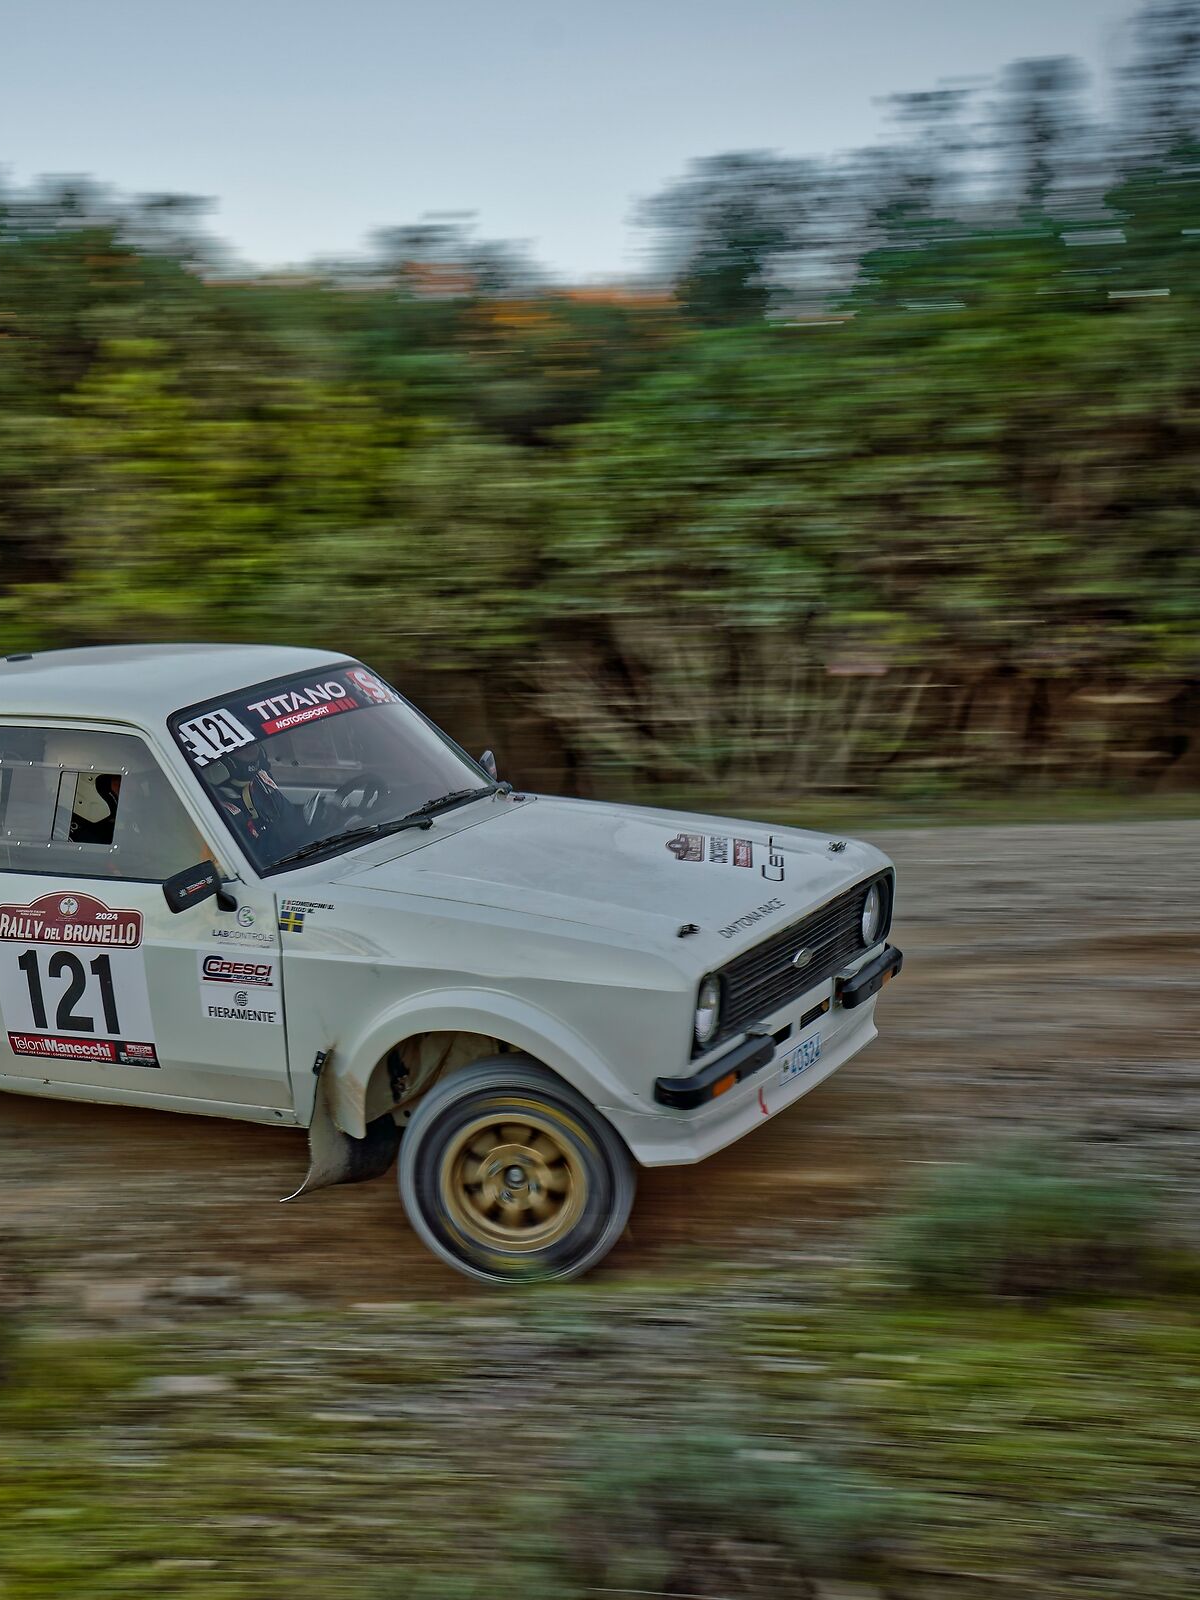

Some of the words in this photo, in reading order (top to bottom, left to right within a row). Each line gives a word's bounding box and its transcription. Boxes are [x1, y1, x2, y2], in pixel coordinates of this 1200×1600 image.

[247, 681, 347, 721] TITANO
[275, 705, 330, 729] MOTORSPORT
[187, 713, 245, 751] 121
[95, 912, 119, 921] 2024
[757, 897, 786, 917] RACE
[0, 913, 44, 939] RALLY
[44, 927, 61, 941] DEL
[64, 922, 137, 945] BRUNELLO
[212, 929, 274, 942] LABCONTROLS
[203, 955, 273, 977] CRESCI
[17, 949, 121, 1035] 121
